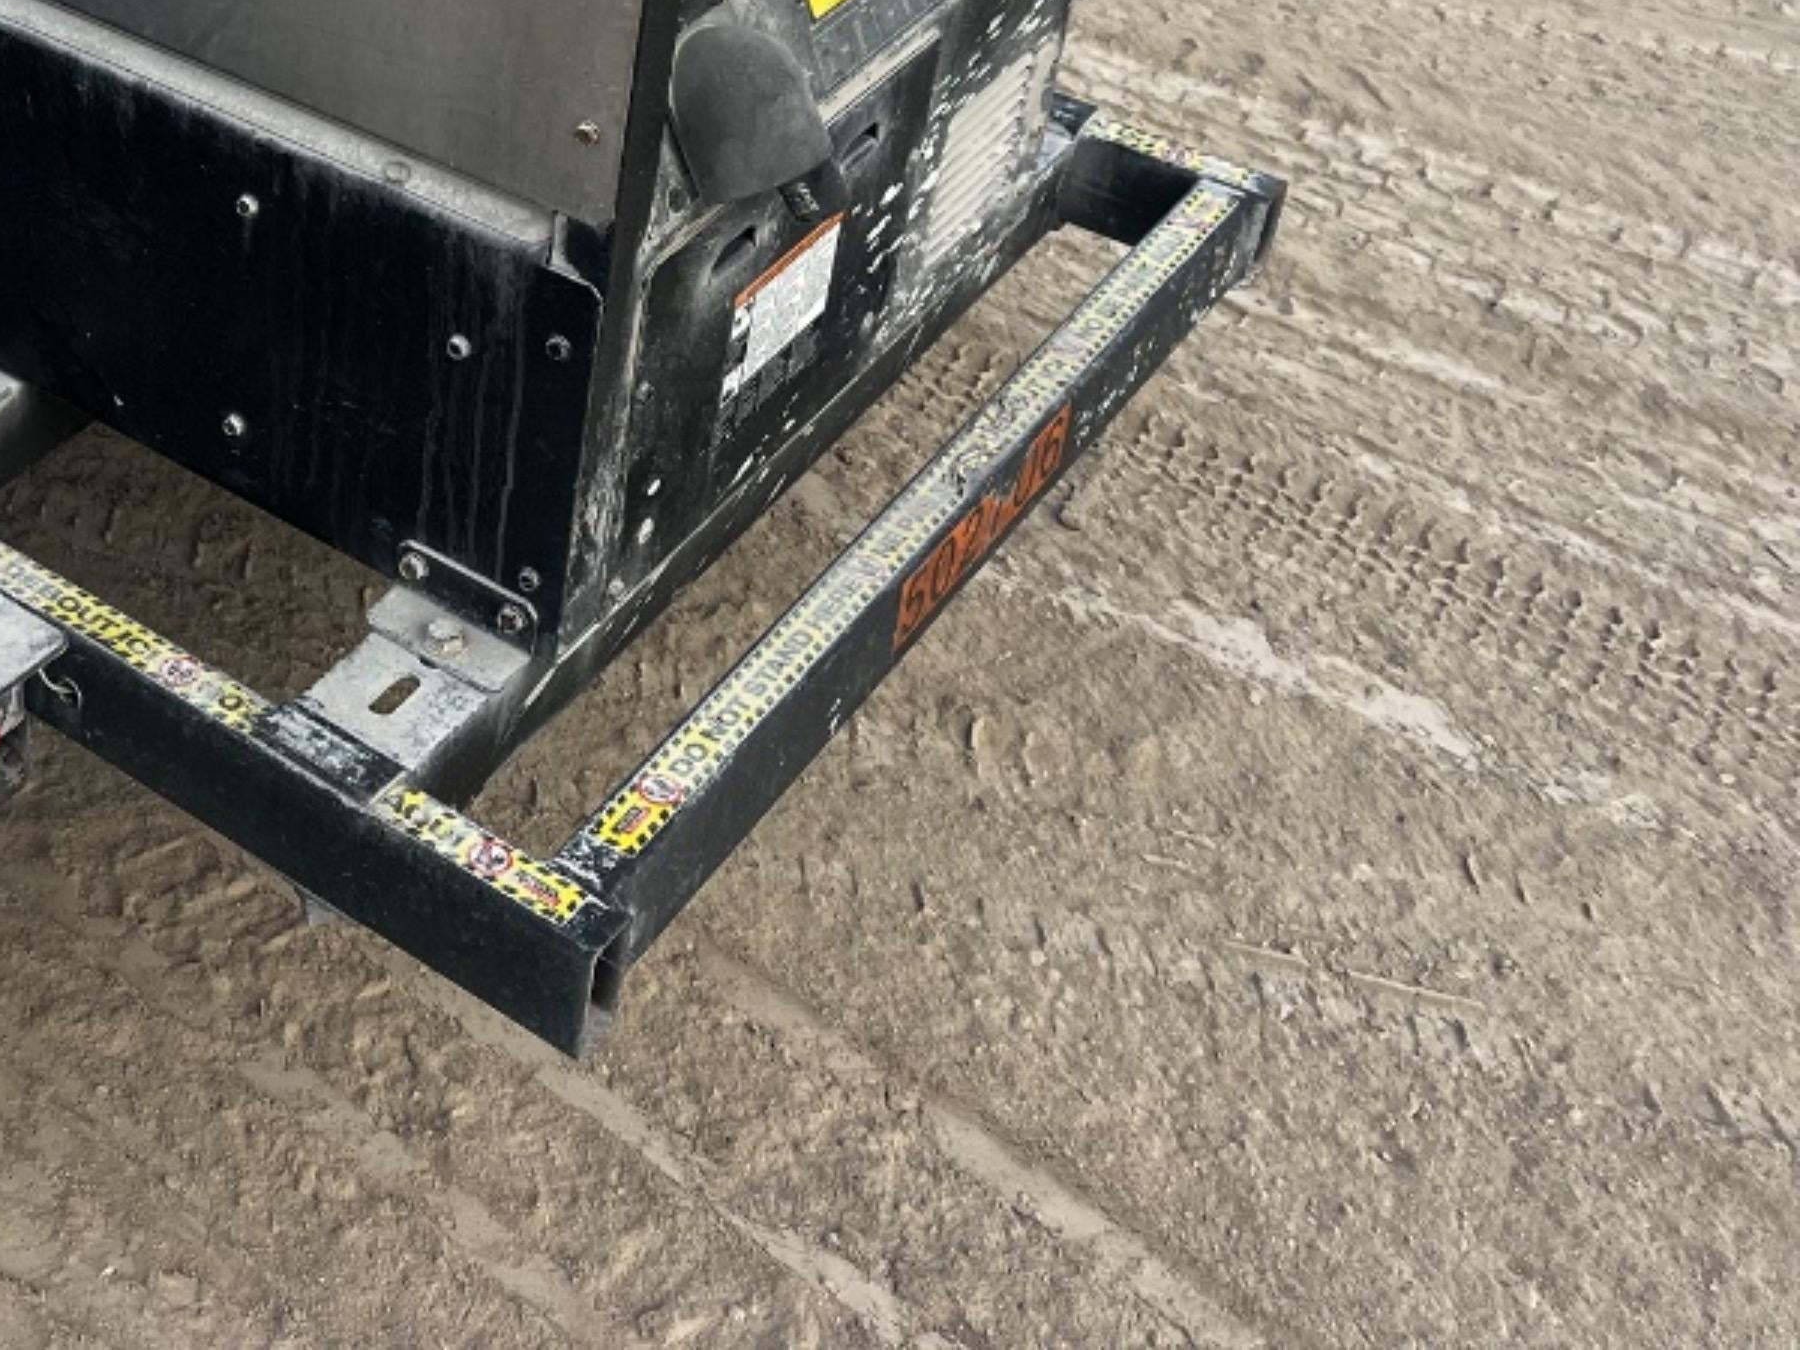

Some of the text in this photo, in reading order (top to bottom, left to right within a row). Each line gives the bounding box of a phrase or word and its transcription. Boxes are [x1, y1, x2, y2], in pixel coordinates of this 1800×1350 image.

[669, 743, 708, 777] DO
[699, 696, 751, 742] NOT
[742, 630, 813, 696] STAND
